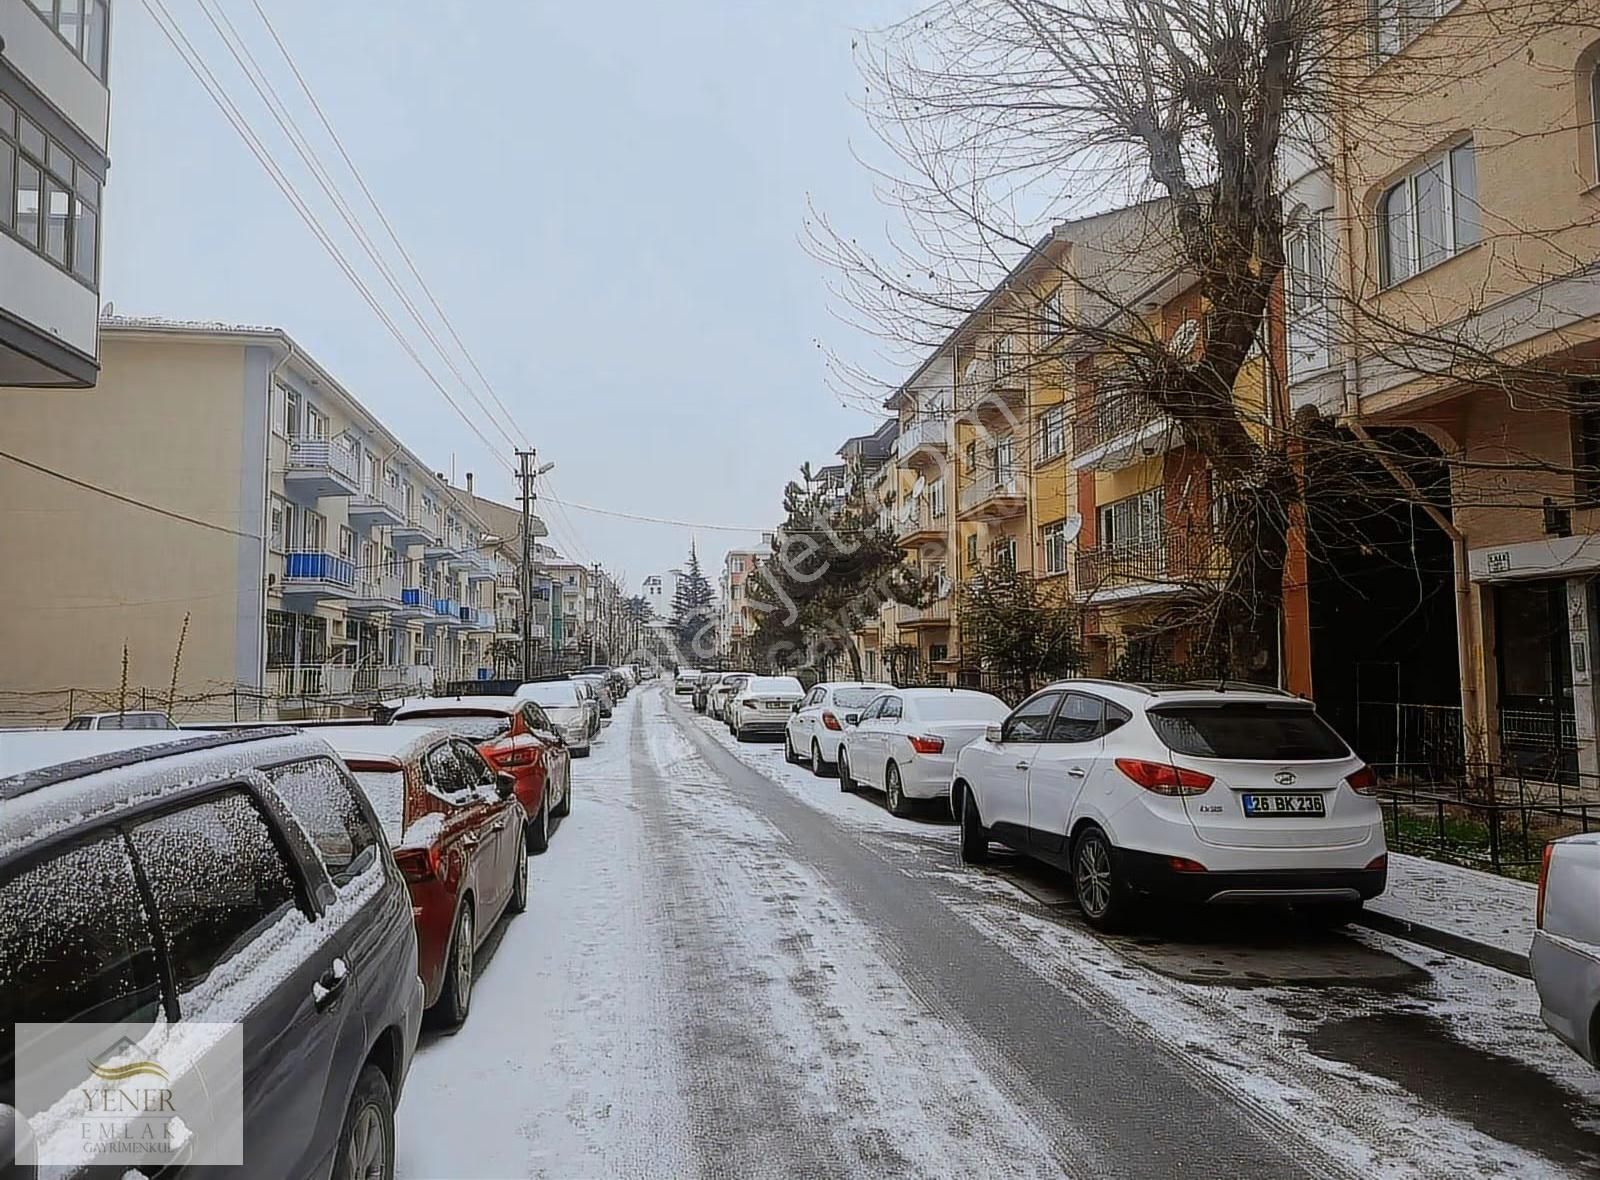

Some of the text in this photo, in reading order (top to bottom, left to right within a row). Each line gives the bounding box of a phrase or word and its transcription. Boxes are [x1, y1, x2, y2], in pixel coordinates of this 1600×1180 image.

[1253, 797, 1269, 811] 26
[1275, 797, 1295, 811] BK
[1297, 797, 1321, 811] 236
